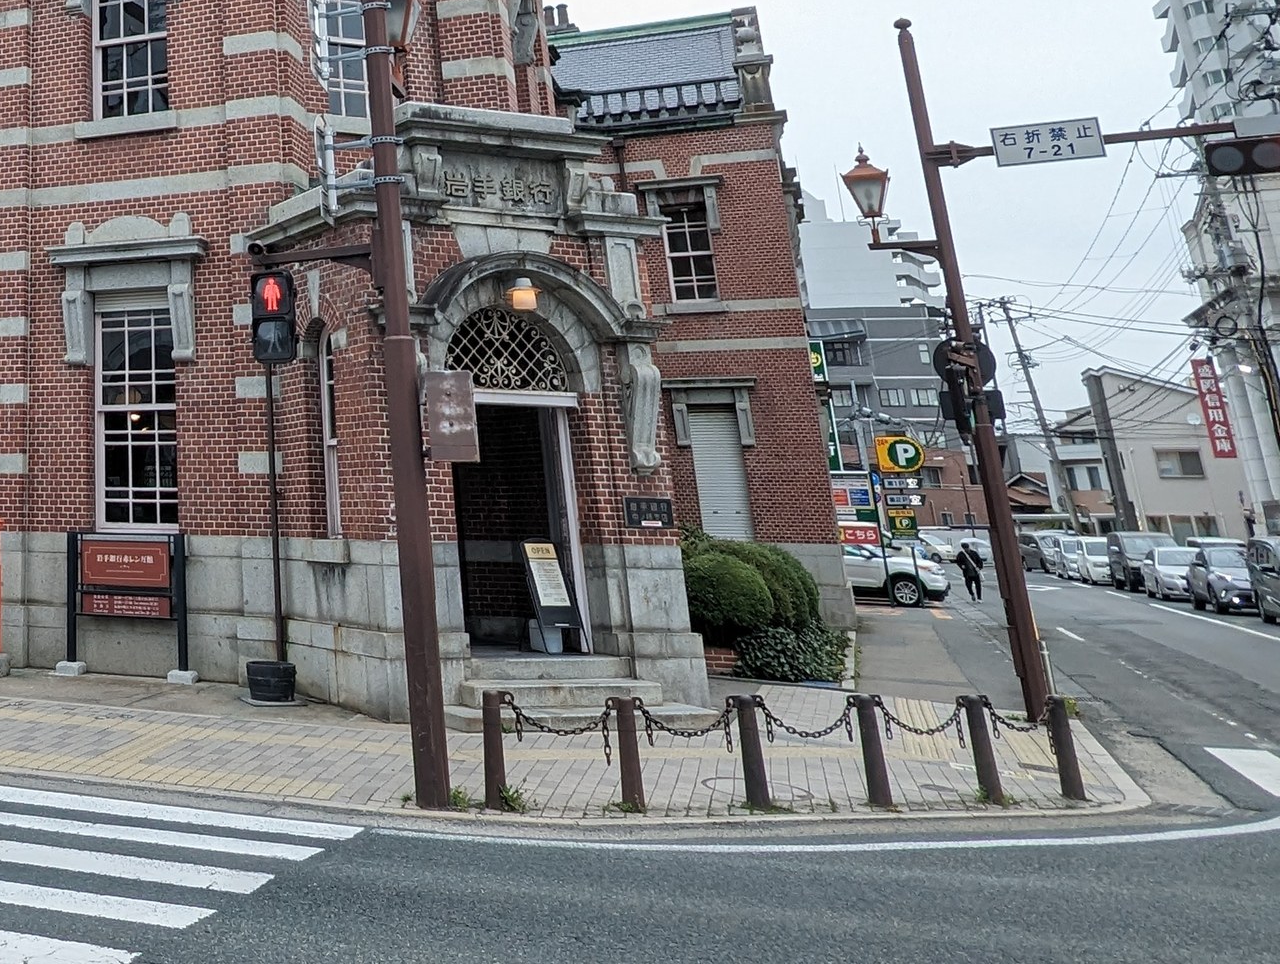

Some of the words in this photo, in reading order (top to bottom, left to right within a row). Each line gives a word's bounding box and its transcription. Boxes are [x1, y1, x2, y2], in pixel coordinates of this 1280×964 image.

[1000, 124, 1094, 147] 右折禁止
[1023, 142, 1075, 159] 7-21
[444, 171, 552, 203] 岩手銀行
[895, 443, 916, 466] P
[845, 530, 876, 539] こちら
[531, 547, 551, 555] OPEN
